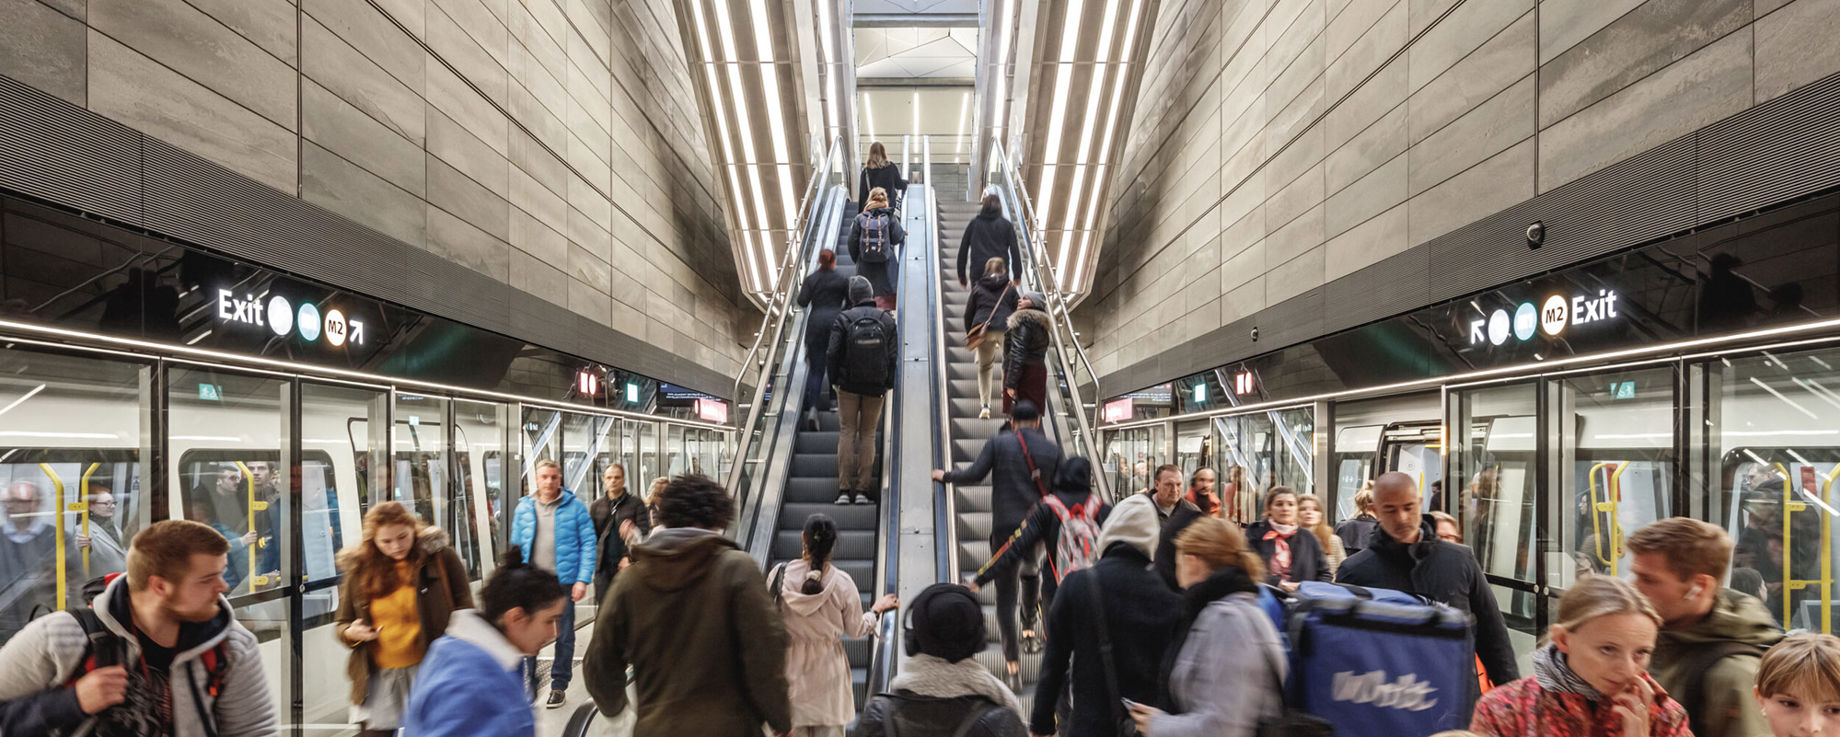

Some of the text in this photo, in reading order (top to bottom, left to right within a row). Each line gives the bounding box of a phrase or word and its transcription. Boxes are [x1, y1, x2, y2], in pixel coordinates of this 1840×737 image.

[218, 289, 264, 326] Exit
[328, 320, 343, 335] M2
[1545, 306, 1564, 323] M2
[1572, 289, 1617, 325] Exit
